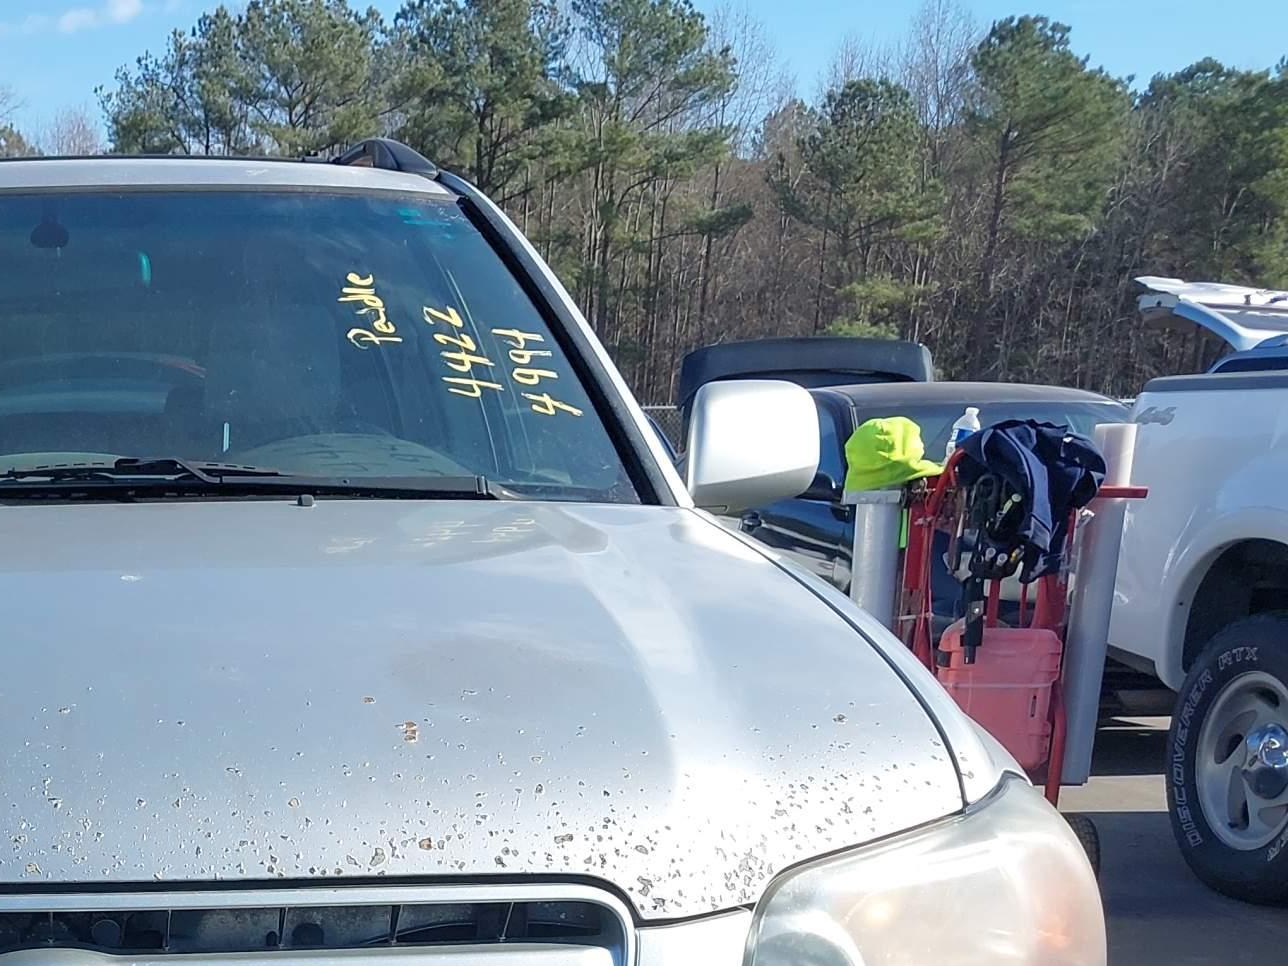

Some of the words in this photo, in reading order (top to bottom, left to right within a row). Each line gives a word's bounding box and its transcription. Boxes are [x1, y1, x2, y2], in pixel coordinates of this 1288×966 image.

[423, 305, 505, 400] 4422
[491, 328, 584, 417] 4994
[1172, 668, 1214, 848] DISCOVERER
[1218, 646, 1259, 671] RTX
